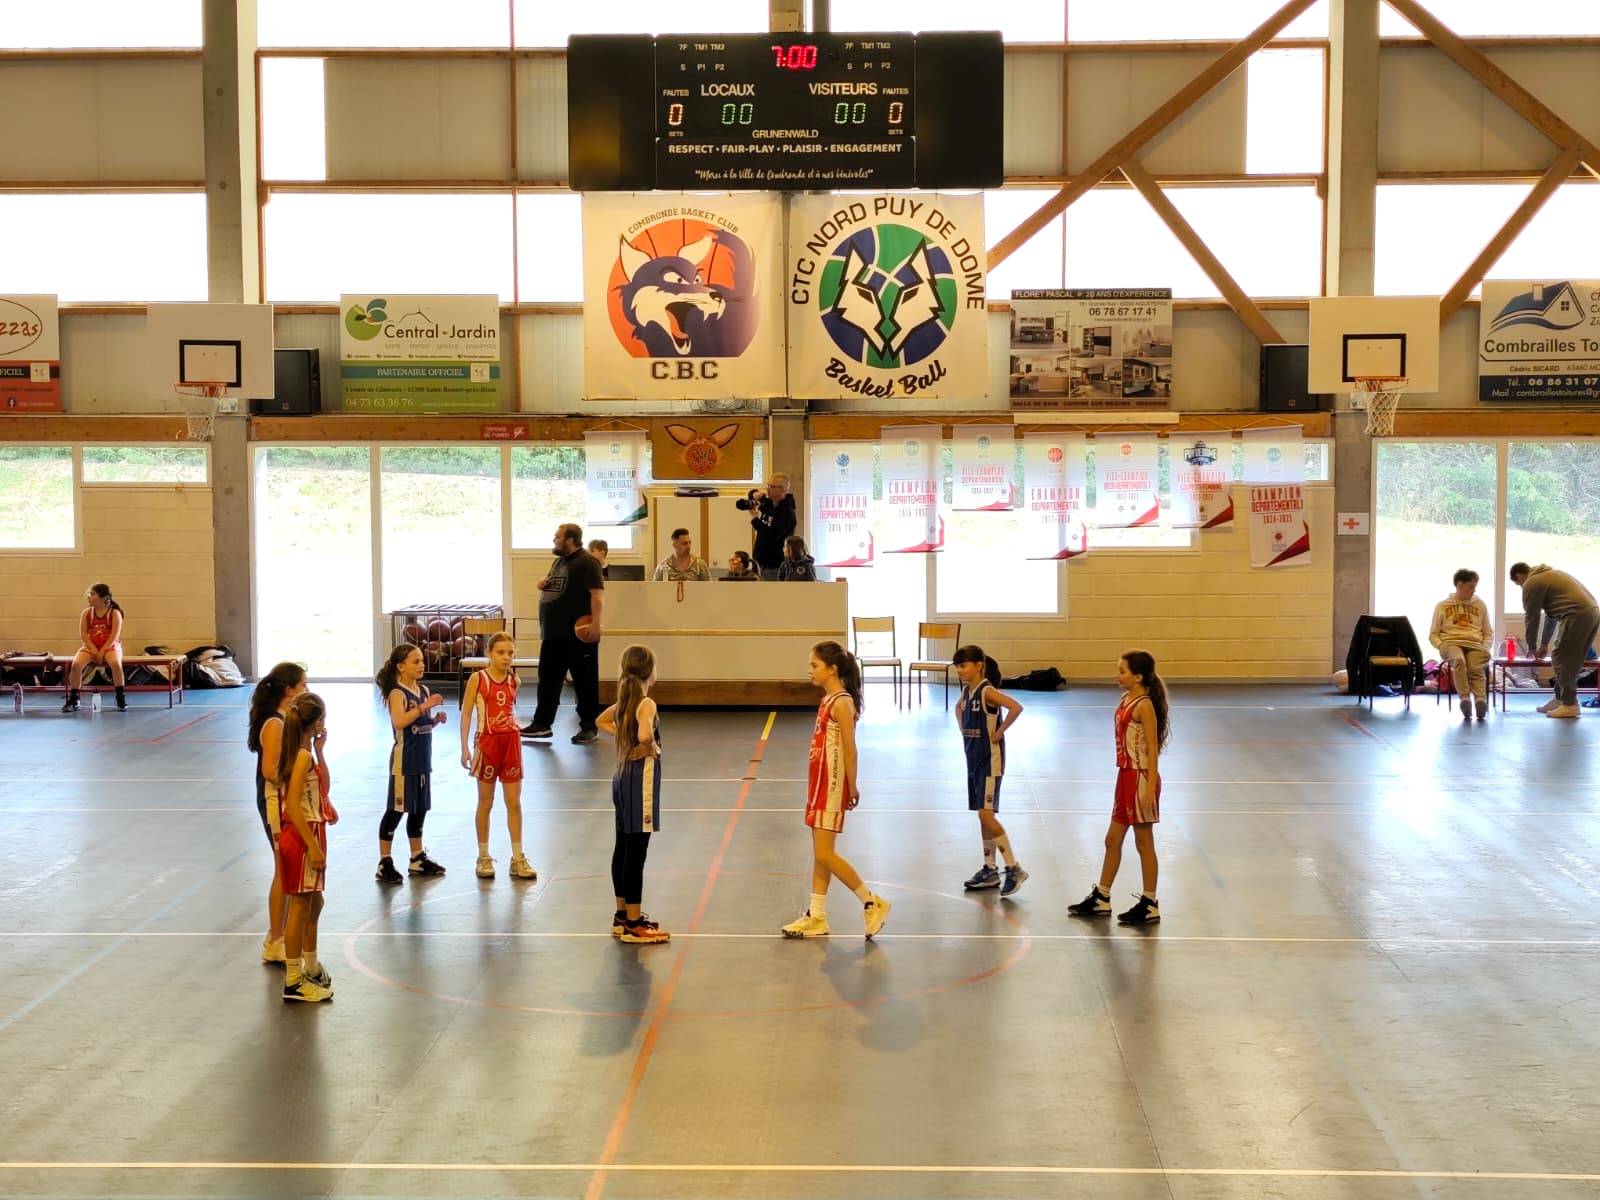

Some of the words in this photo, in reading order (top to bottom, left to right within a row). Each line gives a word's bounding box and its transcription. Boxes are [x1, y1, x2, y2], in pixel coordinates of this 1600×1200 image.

[710, 43, 726, 51] TM2
[771, 45, 818, 69] 7:00
[680, 63, 686, 71] S
[697, 63, 706, 71] P1
[715, 63, 725, 71] P2
[663, 89, 690, 97] FAUTES
[701, 83, 755, 96] LOCAUX
[808, 82, 878, 95] VISITEURS
[668, 103, 684, 126] 0
[721, 103, 754, 125] 00
[834, 102, 866, 124] 00
[888, 102, 904, 124] 0
[752, 129, 819, 139] GRUNENWALD
[668, 145, 714, 154] RESPECT
[721, 145, 775, 154] FAIR-PLAY
[782, 144, 823, 153] PLAISIR
[830, 143, 903, 153] ENGAGEMENT
[756, 169, 765, 179] de
[627, 208, 679, 234] COMBRONDE
[681, 207, 716, 221] BASKET
[716, 217, 739, 234] CLUB
[791, 258, 816, 305] CTC
[806, 202, 868, 256] NORD
[873, 197, 924, 219] PUY
[925, 209, 957, 241] DE
[950, 238, 985, 310] DOME
[1015, 290, 1045, 298] FLORET
[1045, 290, 1075, 298] PASCAL
[1104, 307, 1115, 316] 78
[1132, 307, 1144, 316] 17
[1145, 307, 1157, 316] 41
[384, 324, 439, 339] Central
[449, 324, 496, 339] Jardin
[1484, 339, 1576, 353] Combrailles
[377, 368, 427, 376] PARTENAIRE
[428, 368, 464, 376] OFFICIEL
[652, 361, 719, 381] C.B.C
[824, 357, 896, 399] Basket
[897, 359, 947, 395] Ball
[1528, 378, 1543, 386] 06
[1565, 377, 1579, 386] 31
[1583, 377, 1599, 386] 07
[1491, 388, 1510, 397] Mail
[889, 479, 936, 494] CHAMPION
[1031, 487, 1080, 501] CHAMPION
[1251, 486, 1301, 502] CHAMPION
[818, 495, 868, 509] CHAMPION
[496, 690, 506, 707] 9
[483, 765, 495, 779] 9
